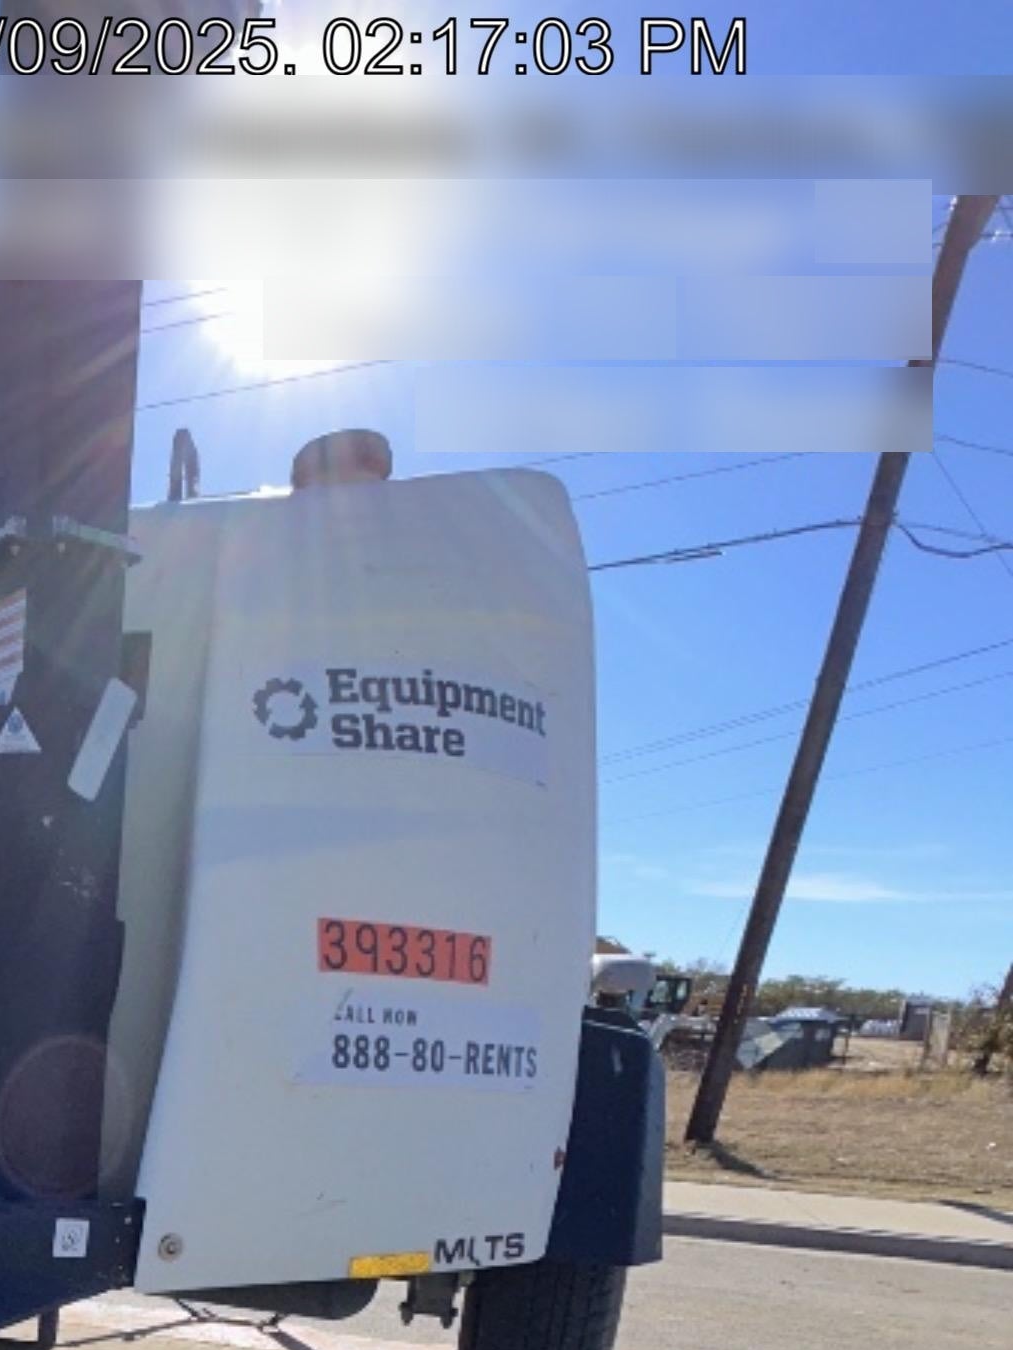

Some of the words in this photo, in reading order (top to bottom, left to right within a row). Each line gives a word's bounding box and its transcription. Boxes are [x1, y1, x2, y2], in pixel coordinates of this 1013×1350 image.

[326, 668, 547, 738] Equipment
[331, 713, 465, 757] Share
[323, 920, 488, 983] 393316
[332, 1033, 538, 1079] 888-80-RENTS
